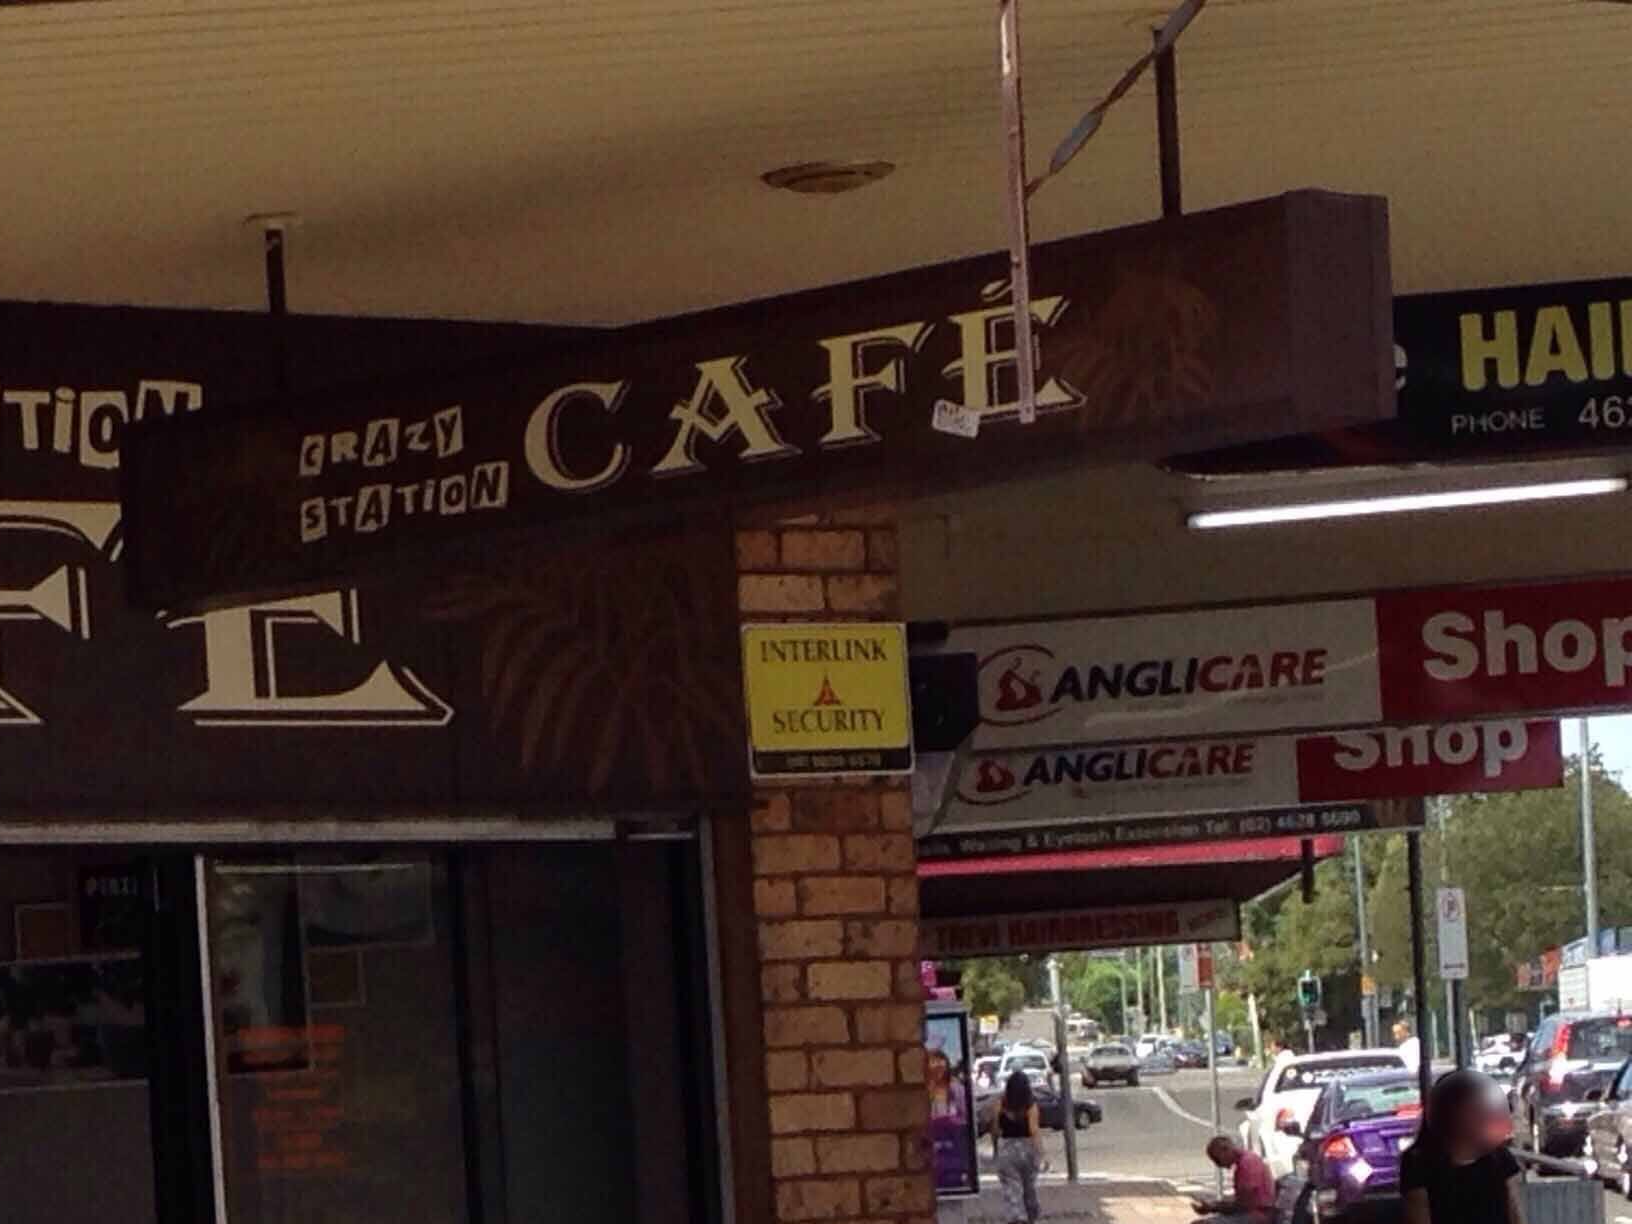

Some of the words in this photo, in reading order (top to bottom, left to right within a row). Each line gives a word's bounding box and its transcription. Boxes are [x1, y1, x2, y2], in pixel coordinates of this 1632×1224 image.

[1459, 298, 1632, 390] HAI
[299, 405, 464, 477] CRAZY
[1451, 408, 1546, 435] PHONE
[1578, 395, 1632, 429] 46
[300, 461, 510, 543] STATION
[761, 638, 888, 663] INTERLINK
[1049, 648, 1327, 705] ANGLICARE
[772, 708, 886, 734] SECURITY
[1022, 739, 1254, 786] ANGLICARE
